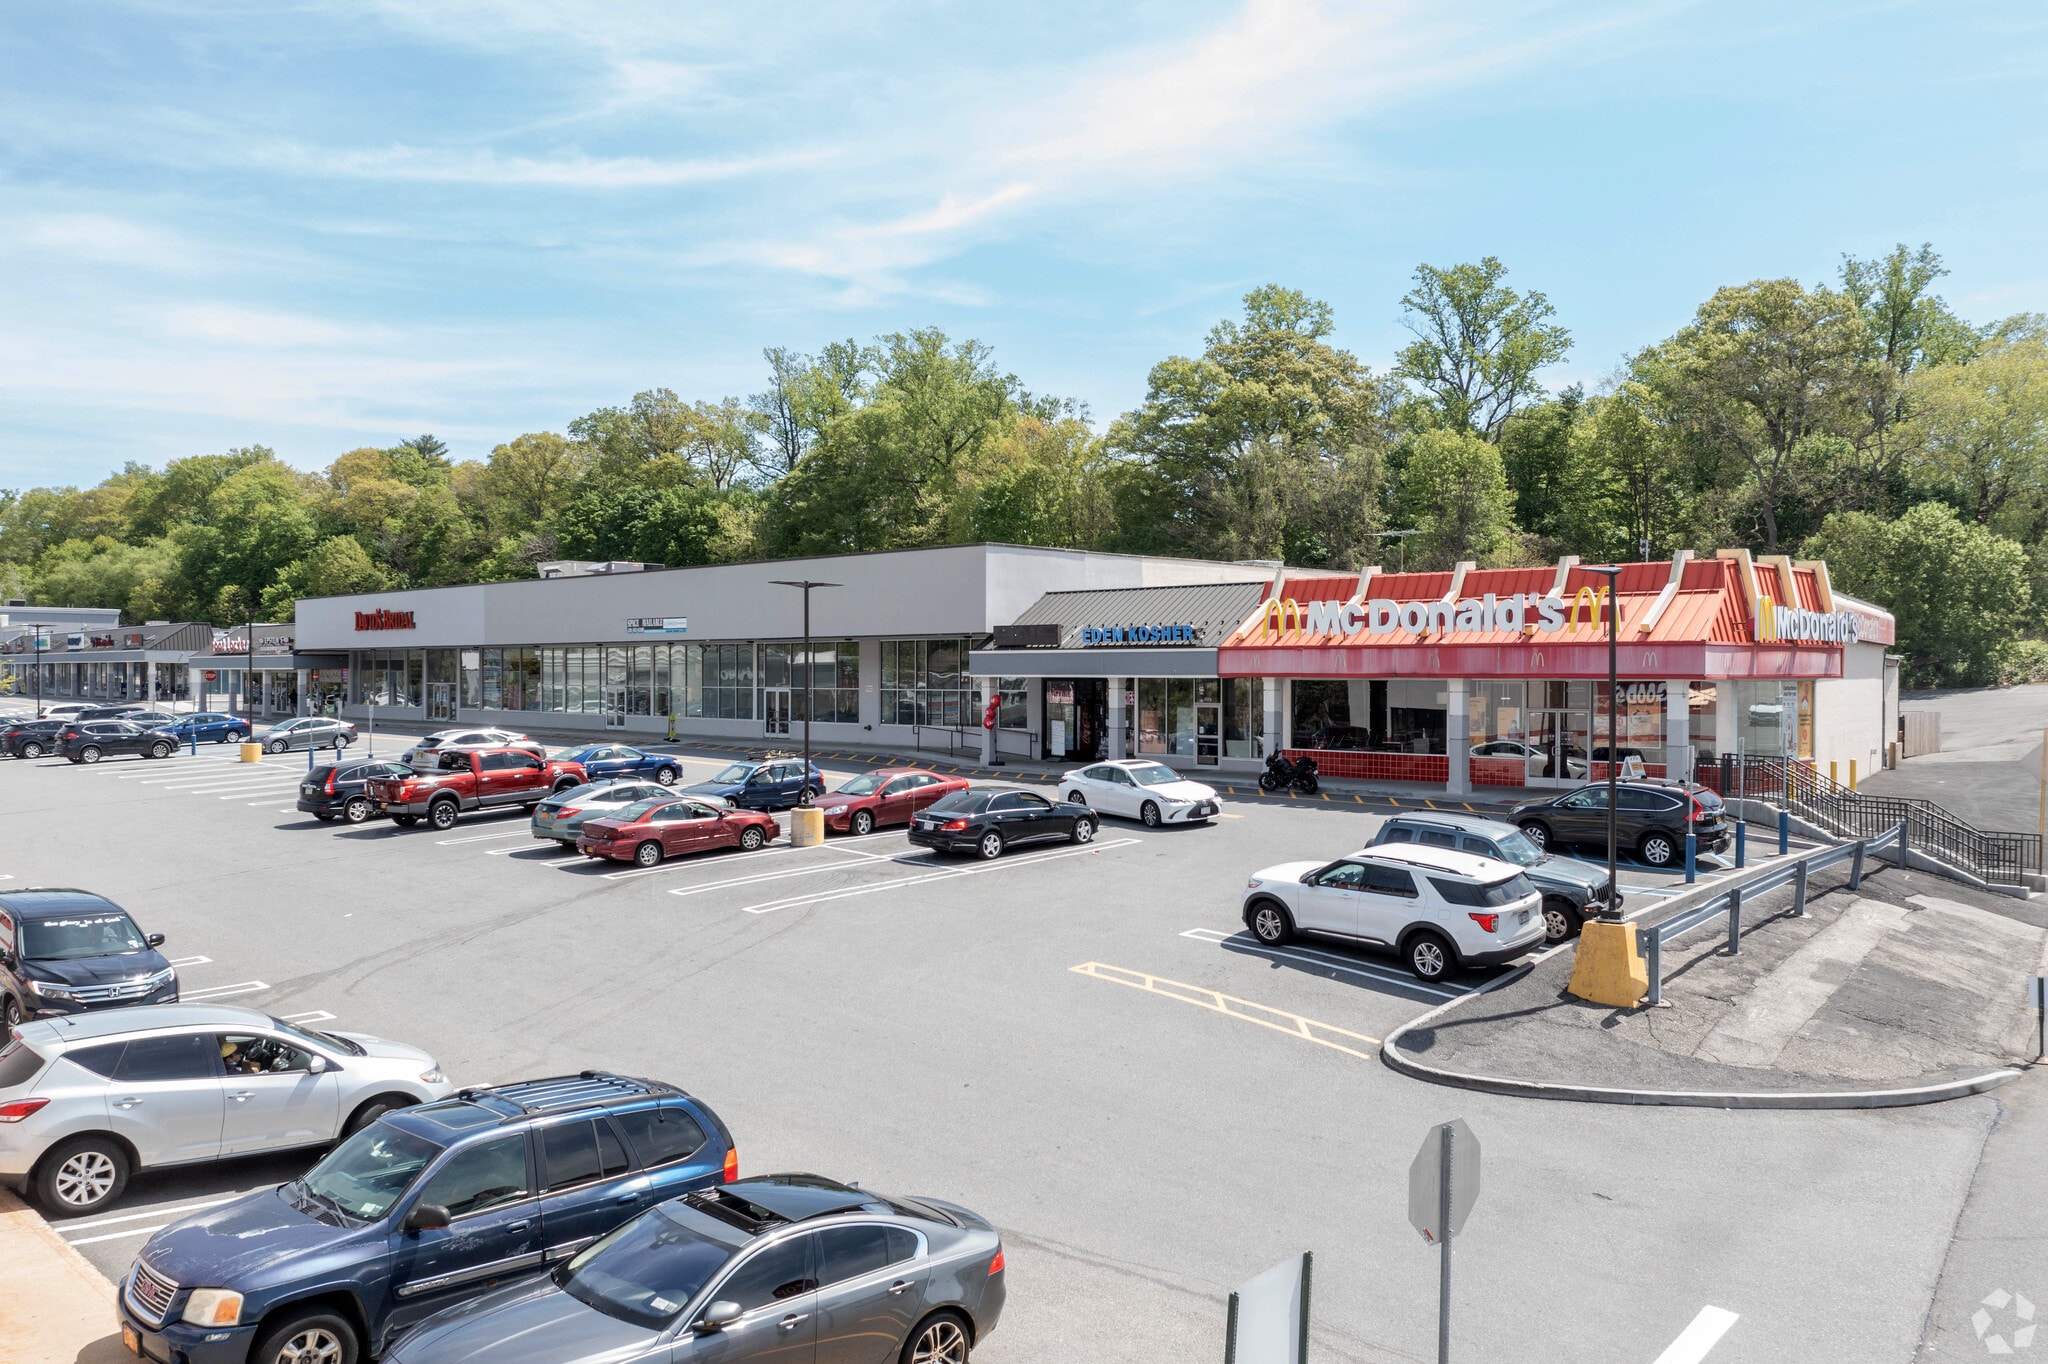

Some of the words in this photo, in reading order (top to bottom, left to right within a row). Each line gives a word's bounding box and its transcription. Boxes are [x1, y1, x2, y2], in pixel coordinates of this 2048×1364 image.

[383, 609, 416, 629] BRIDAL
[1306, 593, 1566, 636] McDonald's
[1777, 606, 1860, 643] McDonald's
[1082, 627, 1123, 643] EDEN
[1128, 625, 1193, 642] KOSHER
